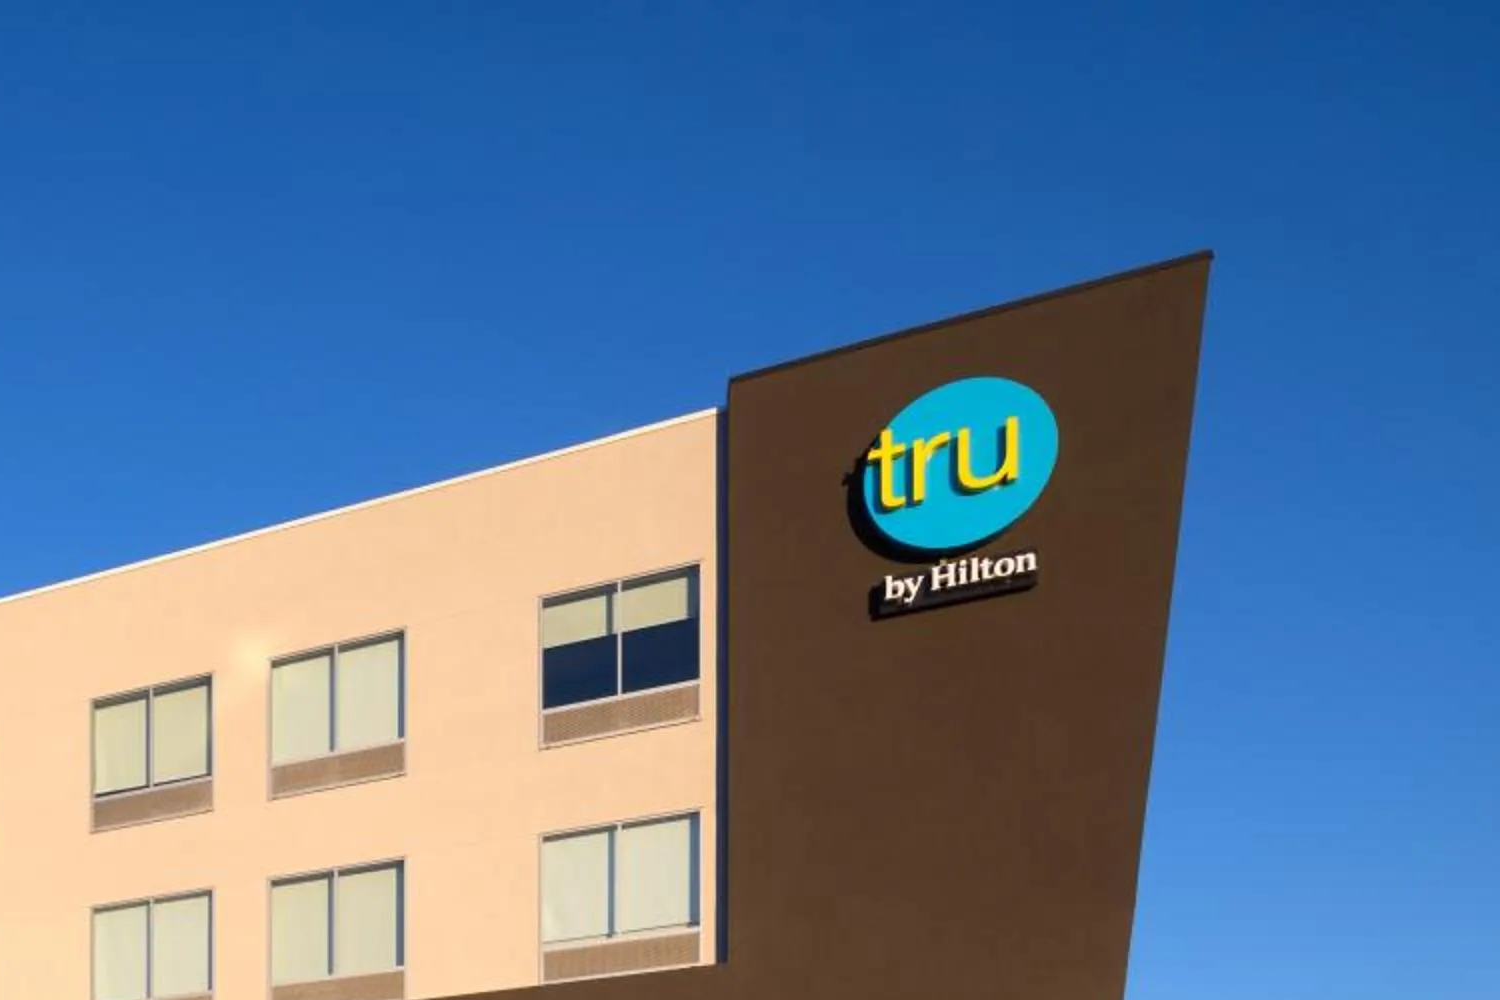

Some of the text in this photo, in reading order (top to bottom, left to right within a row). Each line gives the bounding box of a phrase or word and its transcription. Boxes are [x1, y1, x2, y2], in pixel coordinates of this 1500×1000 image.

[867, 415, 1019, 509] tru
[884, 552, 1037, 603] by Hilton
